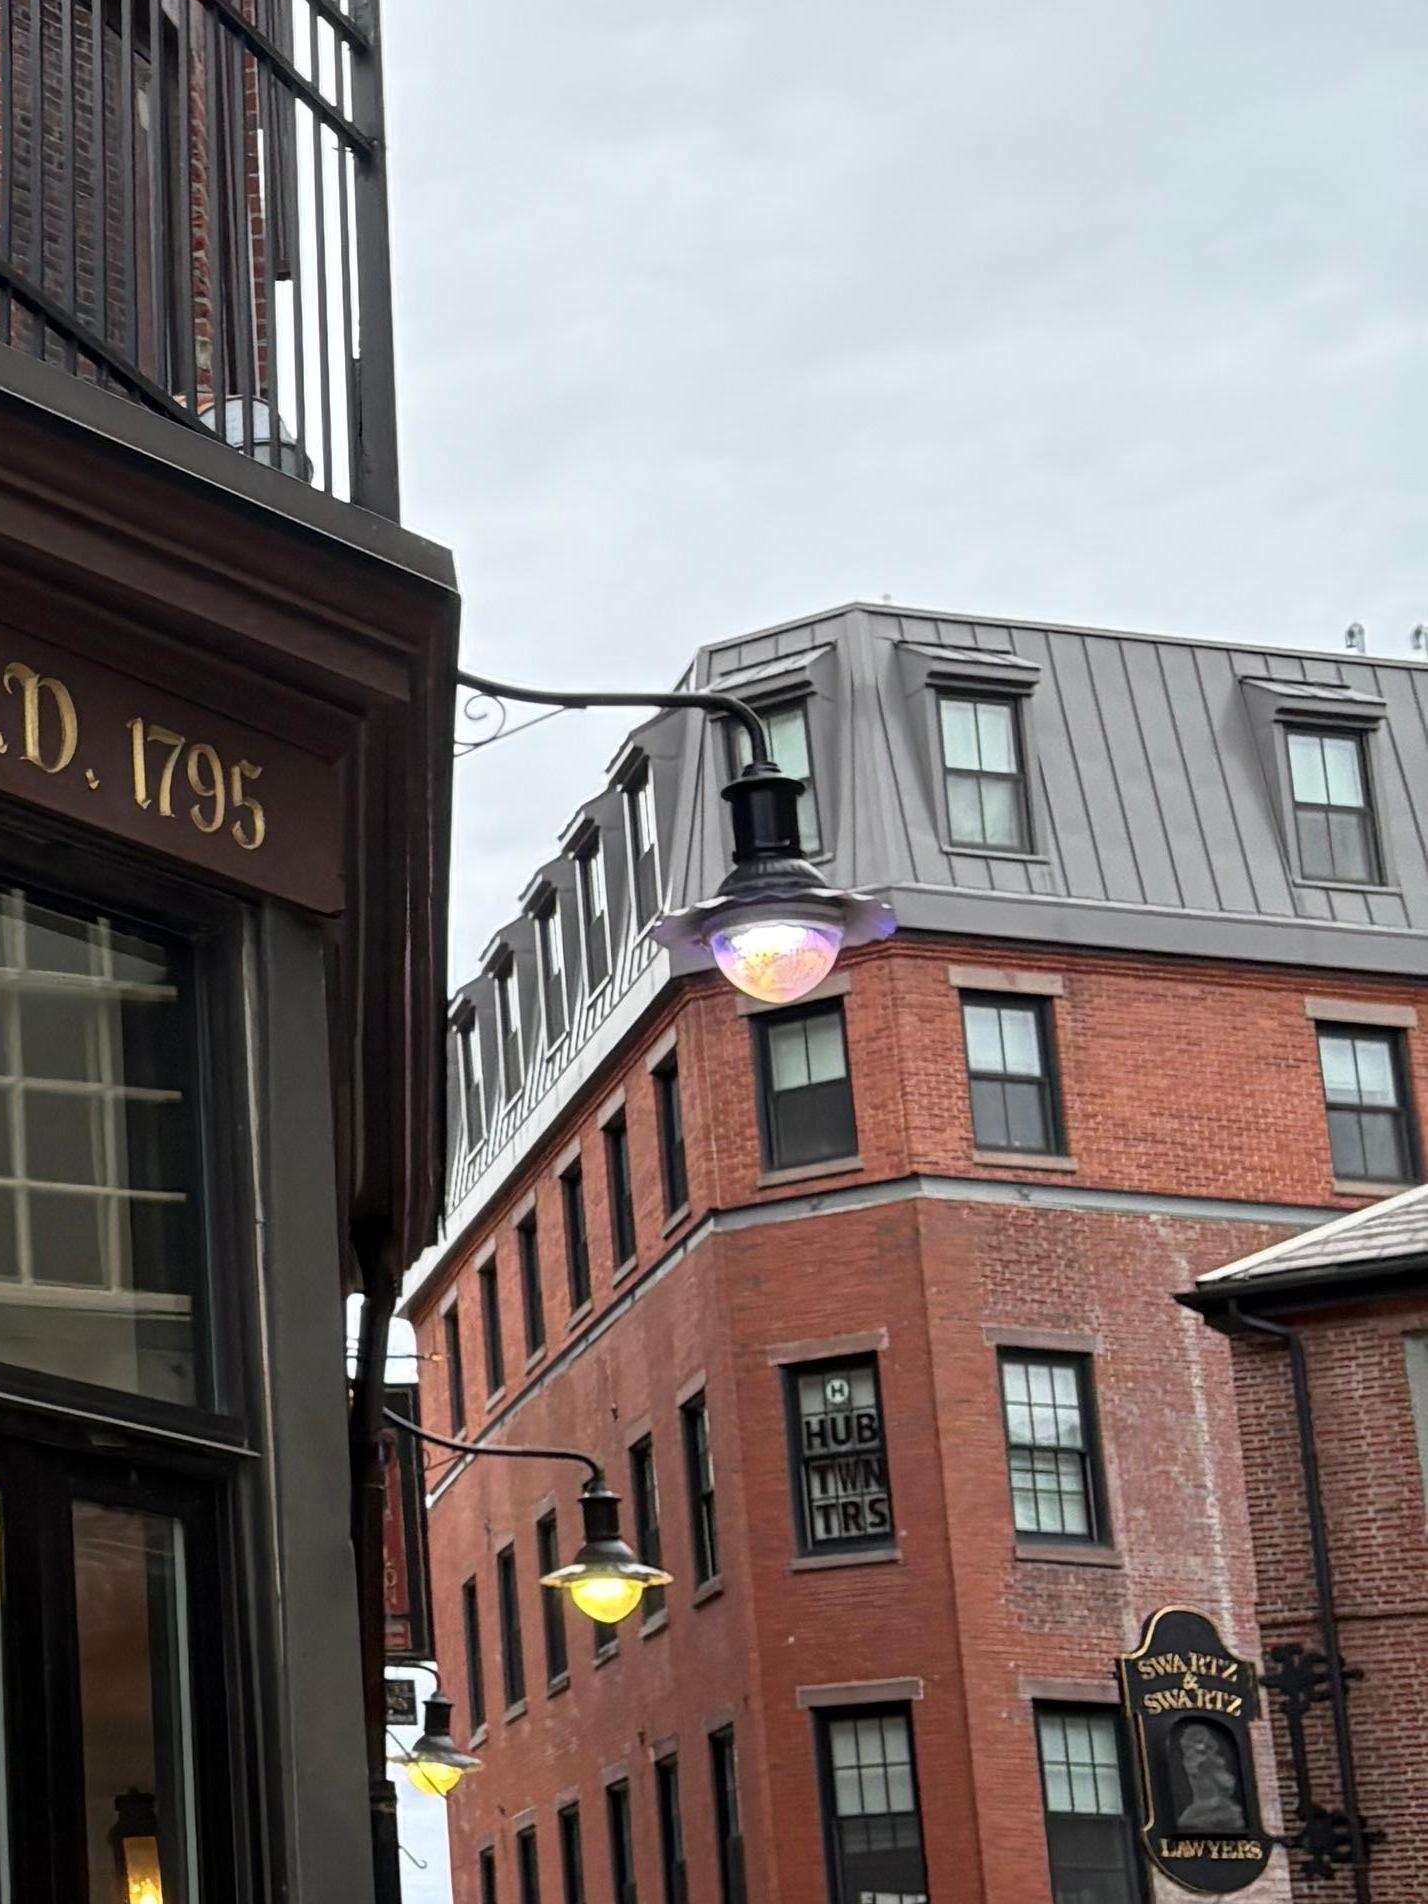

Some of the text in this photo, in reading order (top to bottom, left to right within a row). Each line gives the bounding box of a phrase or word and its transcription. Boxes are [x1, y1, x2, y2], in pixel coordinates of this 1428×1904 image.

[128, 716, 267, 851] 1795
[805, 1413, 878, 1450] HUB
[812, 1458, 884, 1496] TWN
[816, 1498, 887, 1535] TRS
[1137, 1651, 1238, 1683] SWARTZ
[1182, 1671, 1200, 1690] &
[1143, 1688, 1243, 1717] SWARTZ
[1159, 1838, 1263, 1860] LAWYERS
